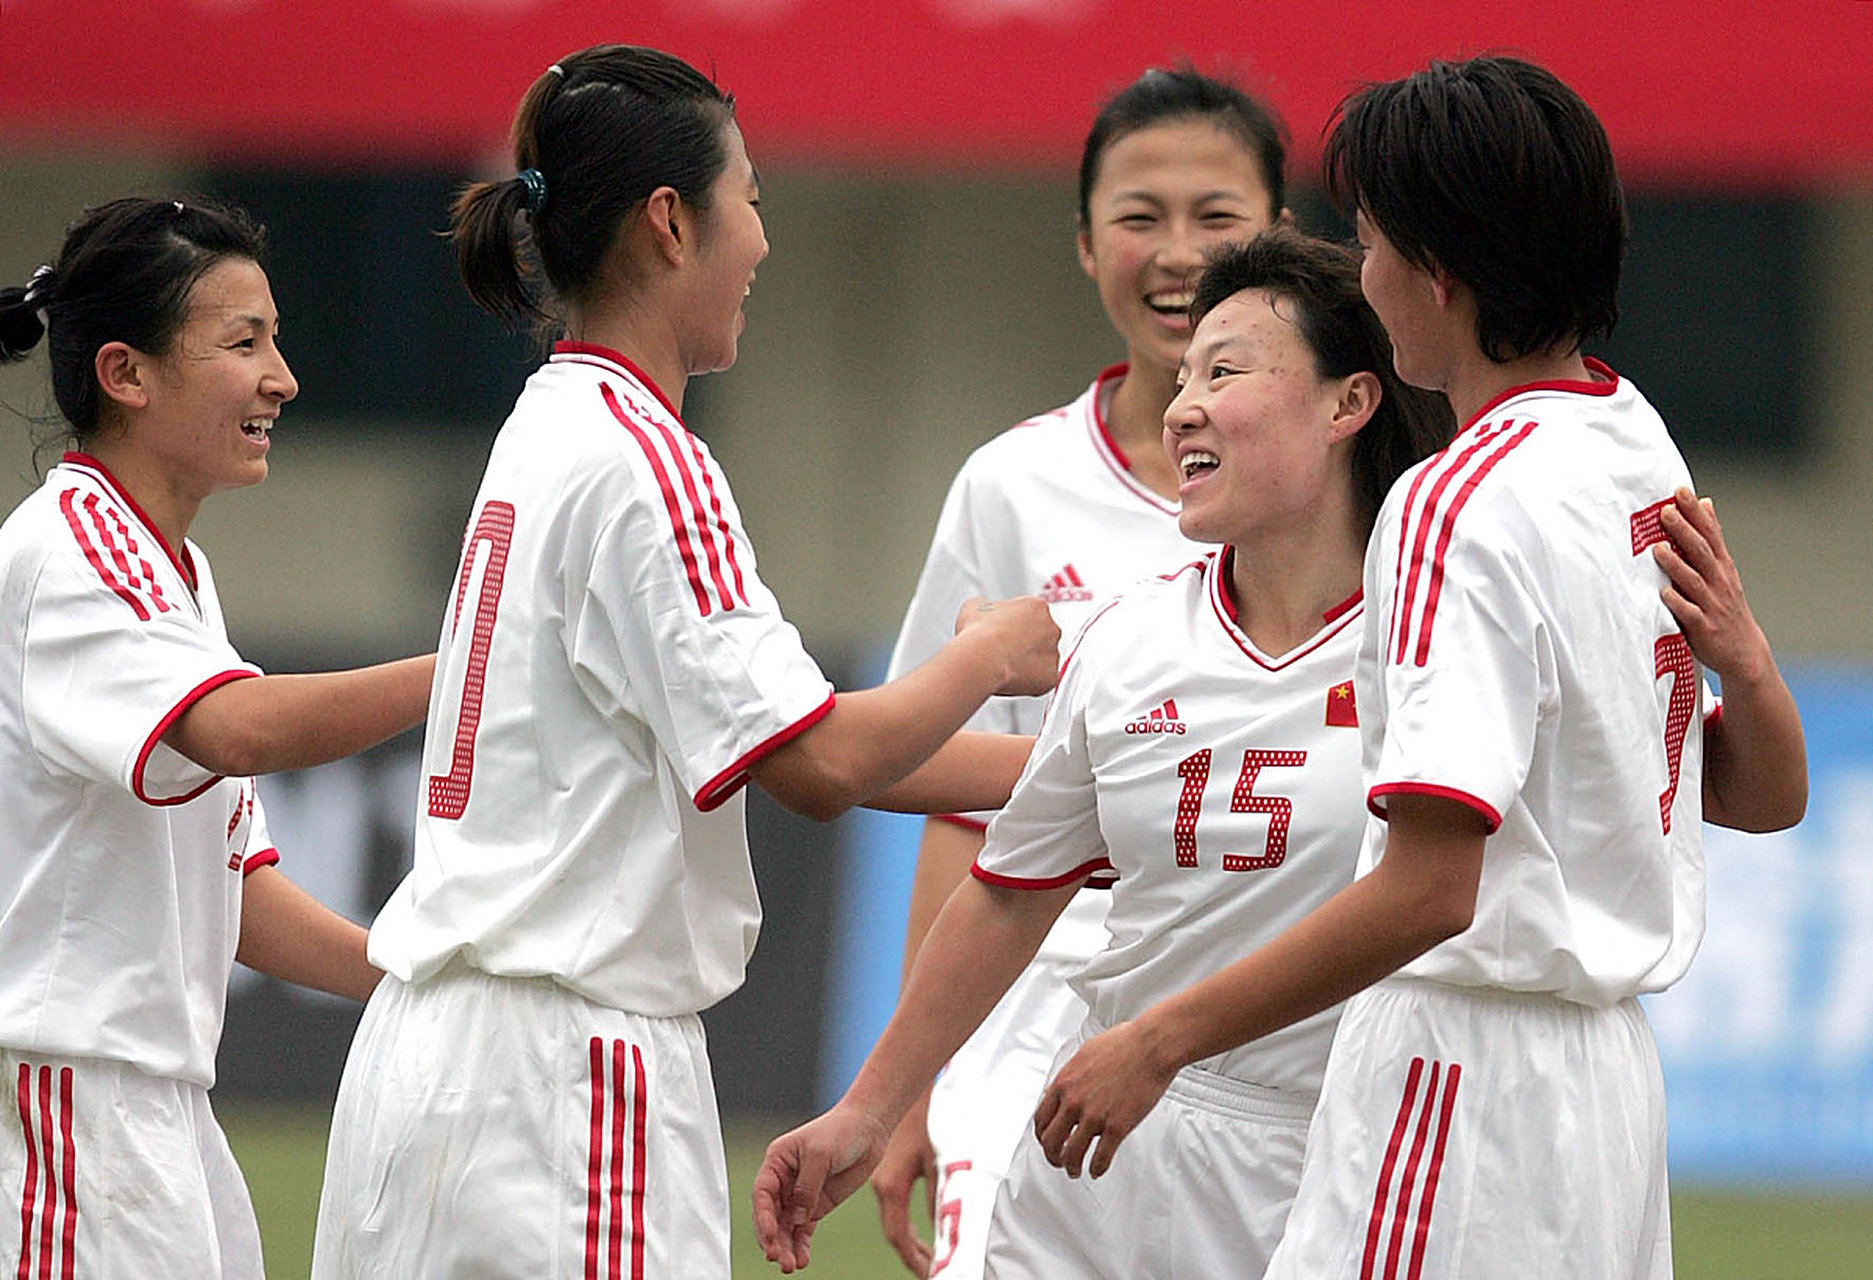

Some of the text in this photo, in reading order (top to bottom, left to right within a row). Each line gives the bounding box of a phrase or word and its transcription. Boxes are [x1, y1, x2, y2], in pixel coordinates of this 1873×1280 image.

[428, 500, 515, 820] 0
[1124, 719, 1187, 736] adidas
[1174, 748, 1308, 872] 15
